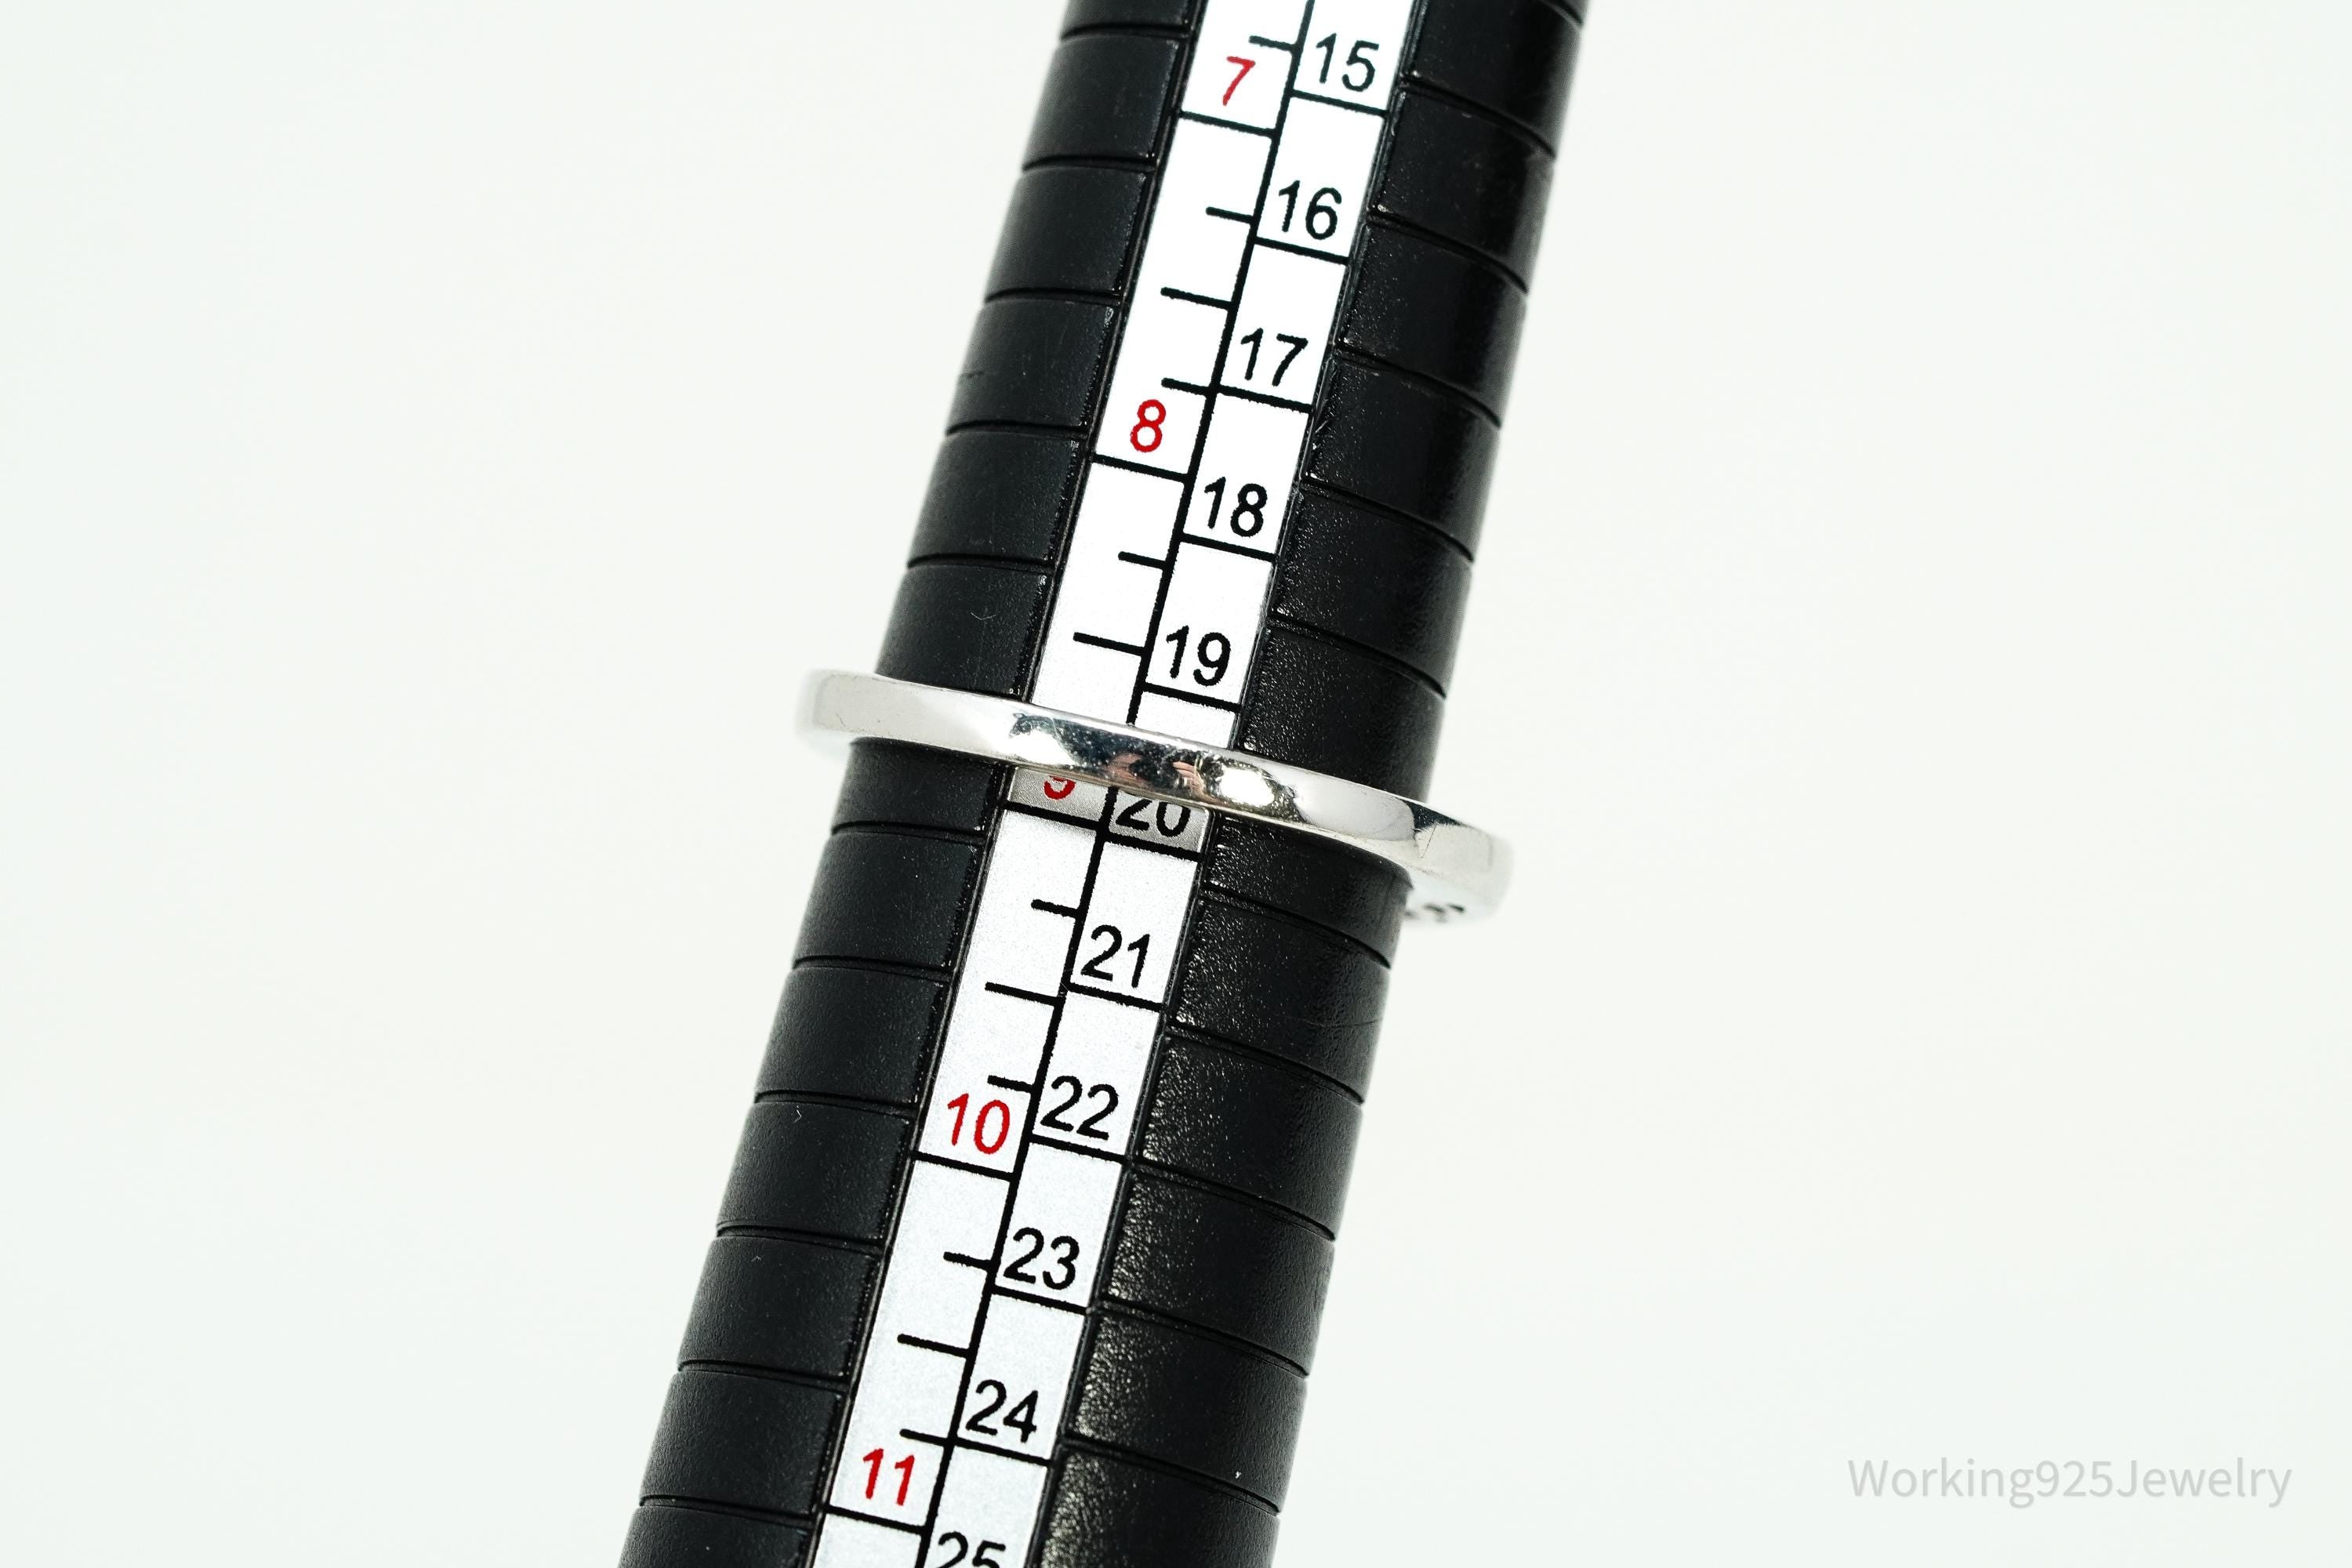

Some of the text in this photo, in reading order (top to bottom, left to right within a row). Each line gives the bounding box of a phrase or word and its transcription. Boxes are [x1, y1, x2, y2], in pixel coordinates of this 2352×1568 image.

[1223, 57, 1254, 105] 7
[1317, 34, 1378, 92] 15
[1279, 180, 1341, 240] 16
[1241, 328, 1308, 386] 17
[1131, 400, 1166, 452] 8
[1204, 477, 1267, 537] 18
[1166, 626, 1231, 687] 19
[1081, 925, 1149, 988] 21
[948, 1094, 1010, 1154] 10
[1040, 1076, 1119, 1140] 22
[1004, 1227, 1080, 1290] 23
[966, 1380, 1038, 1443] 24
[863, 1449, 914, 1505] 11
